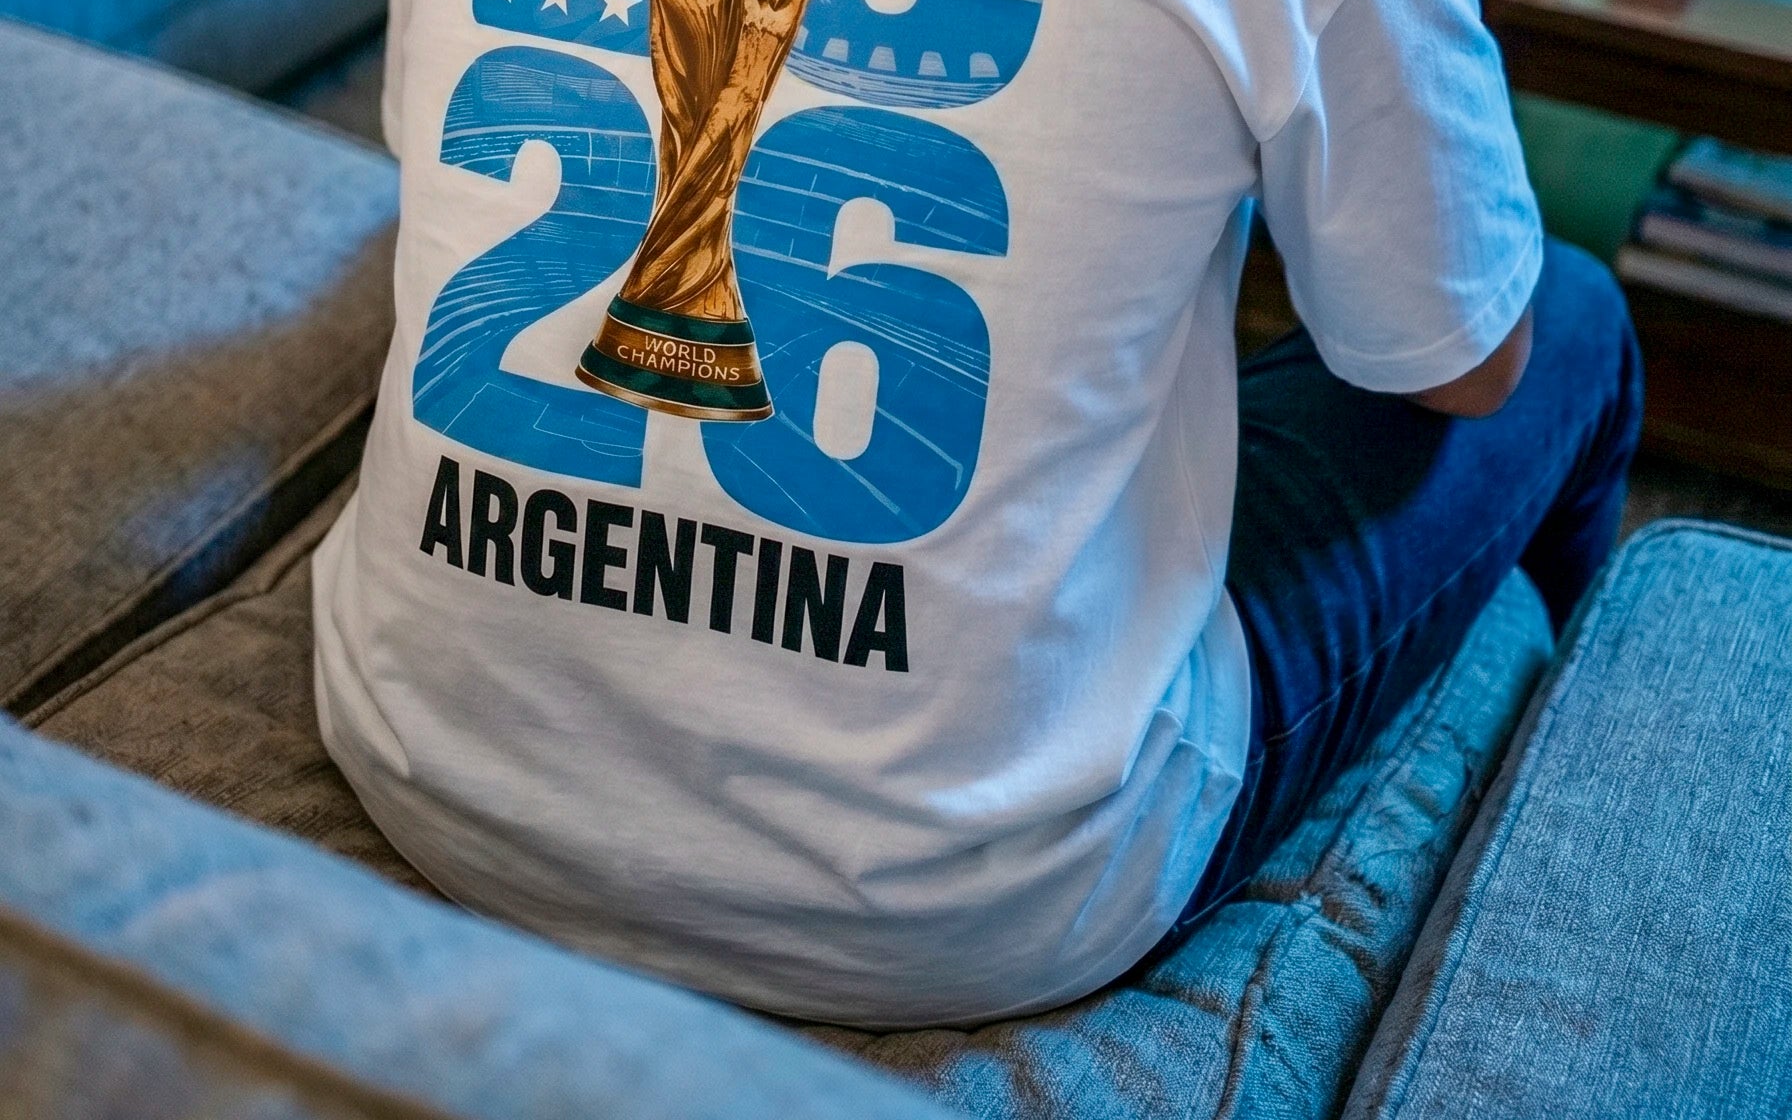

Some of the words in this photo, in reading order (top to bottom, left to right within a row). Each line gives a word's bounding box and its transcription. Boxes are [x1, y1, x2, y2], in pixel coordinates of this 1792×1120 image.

[412, 45, 1010, 544] 26
[645, 335, 716, 364] WORLD
[617, 345, 740, 381] CHAMPIONS
[419, 454, 910, 673] ARGENTINA
